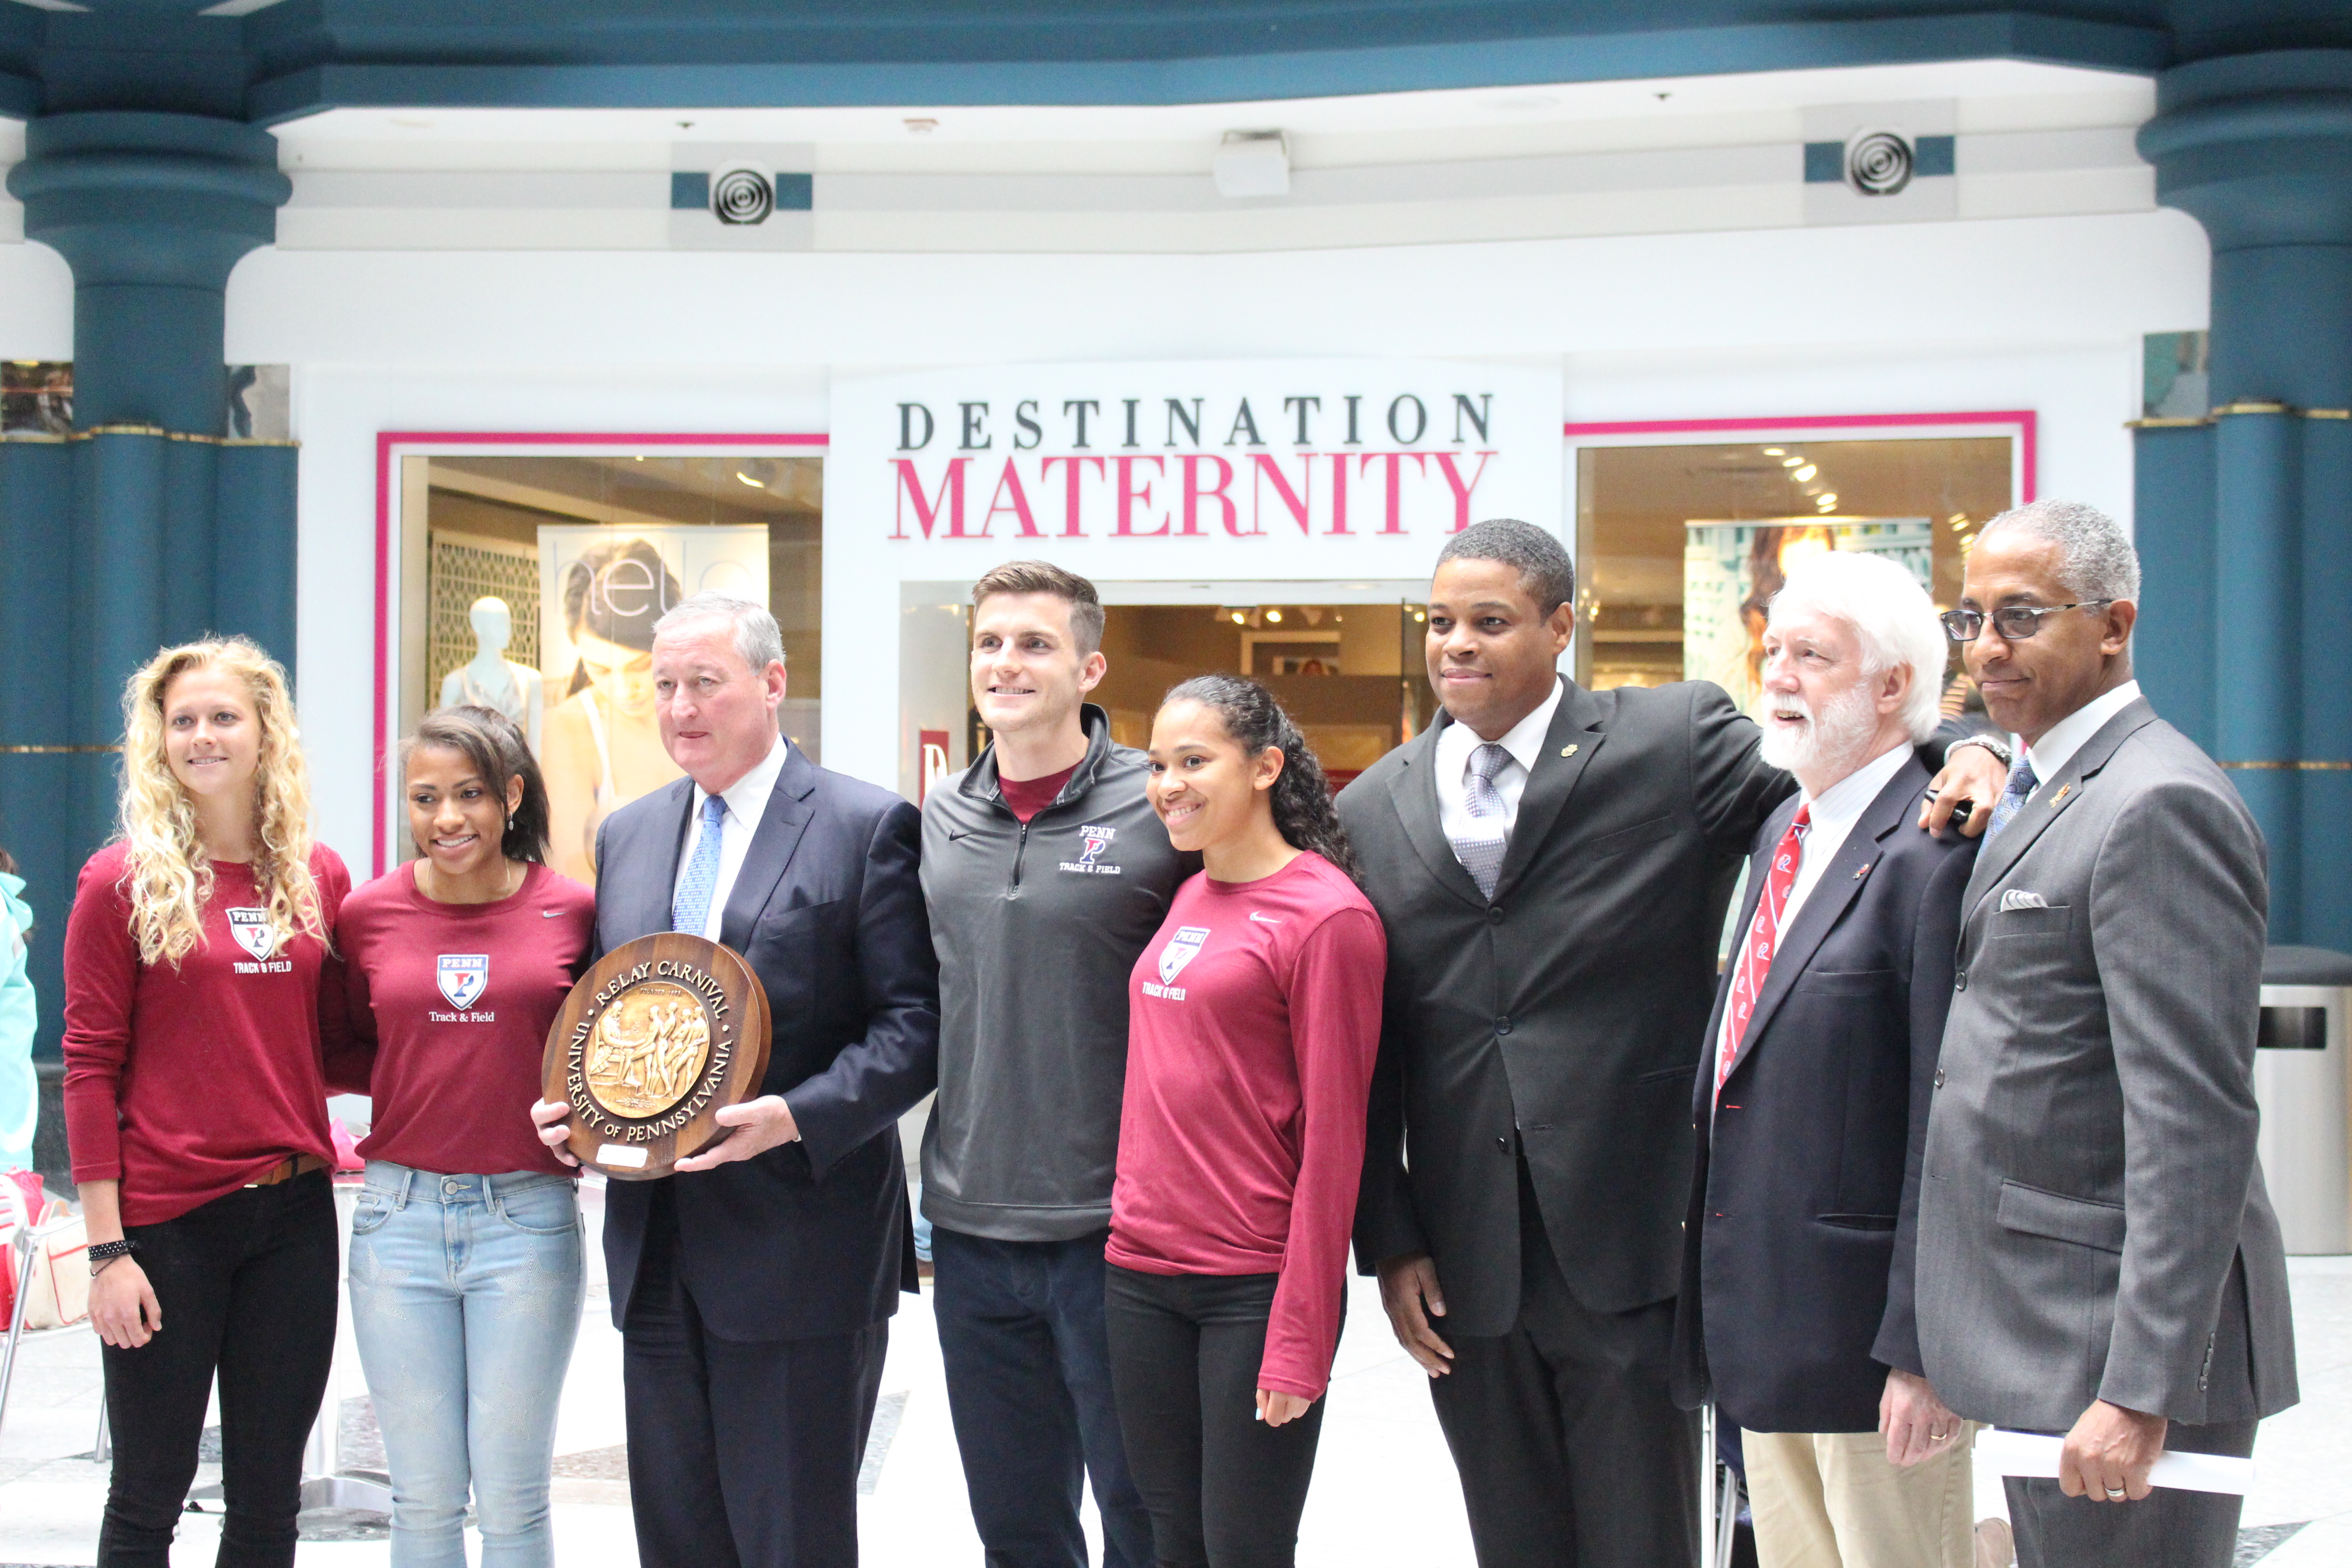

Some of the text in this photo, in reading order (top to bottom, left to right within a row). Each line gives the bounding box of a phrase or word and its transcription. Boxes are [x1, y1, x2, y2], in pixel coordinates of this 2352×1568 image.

[896, 393, 1494, 451] DESTINATION
[888, 451, 1499, 541] MATERNITY
[1079, 825, 1116, 839] PENN
[1059, 862, 1086, 872] TRACK
[1095, 865, 1121, 874] FIELD
[233, 911, 266, 922] PENN
[1176, 931, 1205, 943] PENN
[233, 960, 292, 974] TRACK & FIELD
[441, 958, 483, 968] PENN
[595, 960, 730, 1020] RELAY CARNIVAL
[1142, 981, 1186, 1001] TRACK & FIELD
[429, 1011, 495, 1022] Track & Field
[567, 1022, 733, 1142] UNIVERSITY OF PENNSYLVANIA
